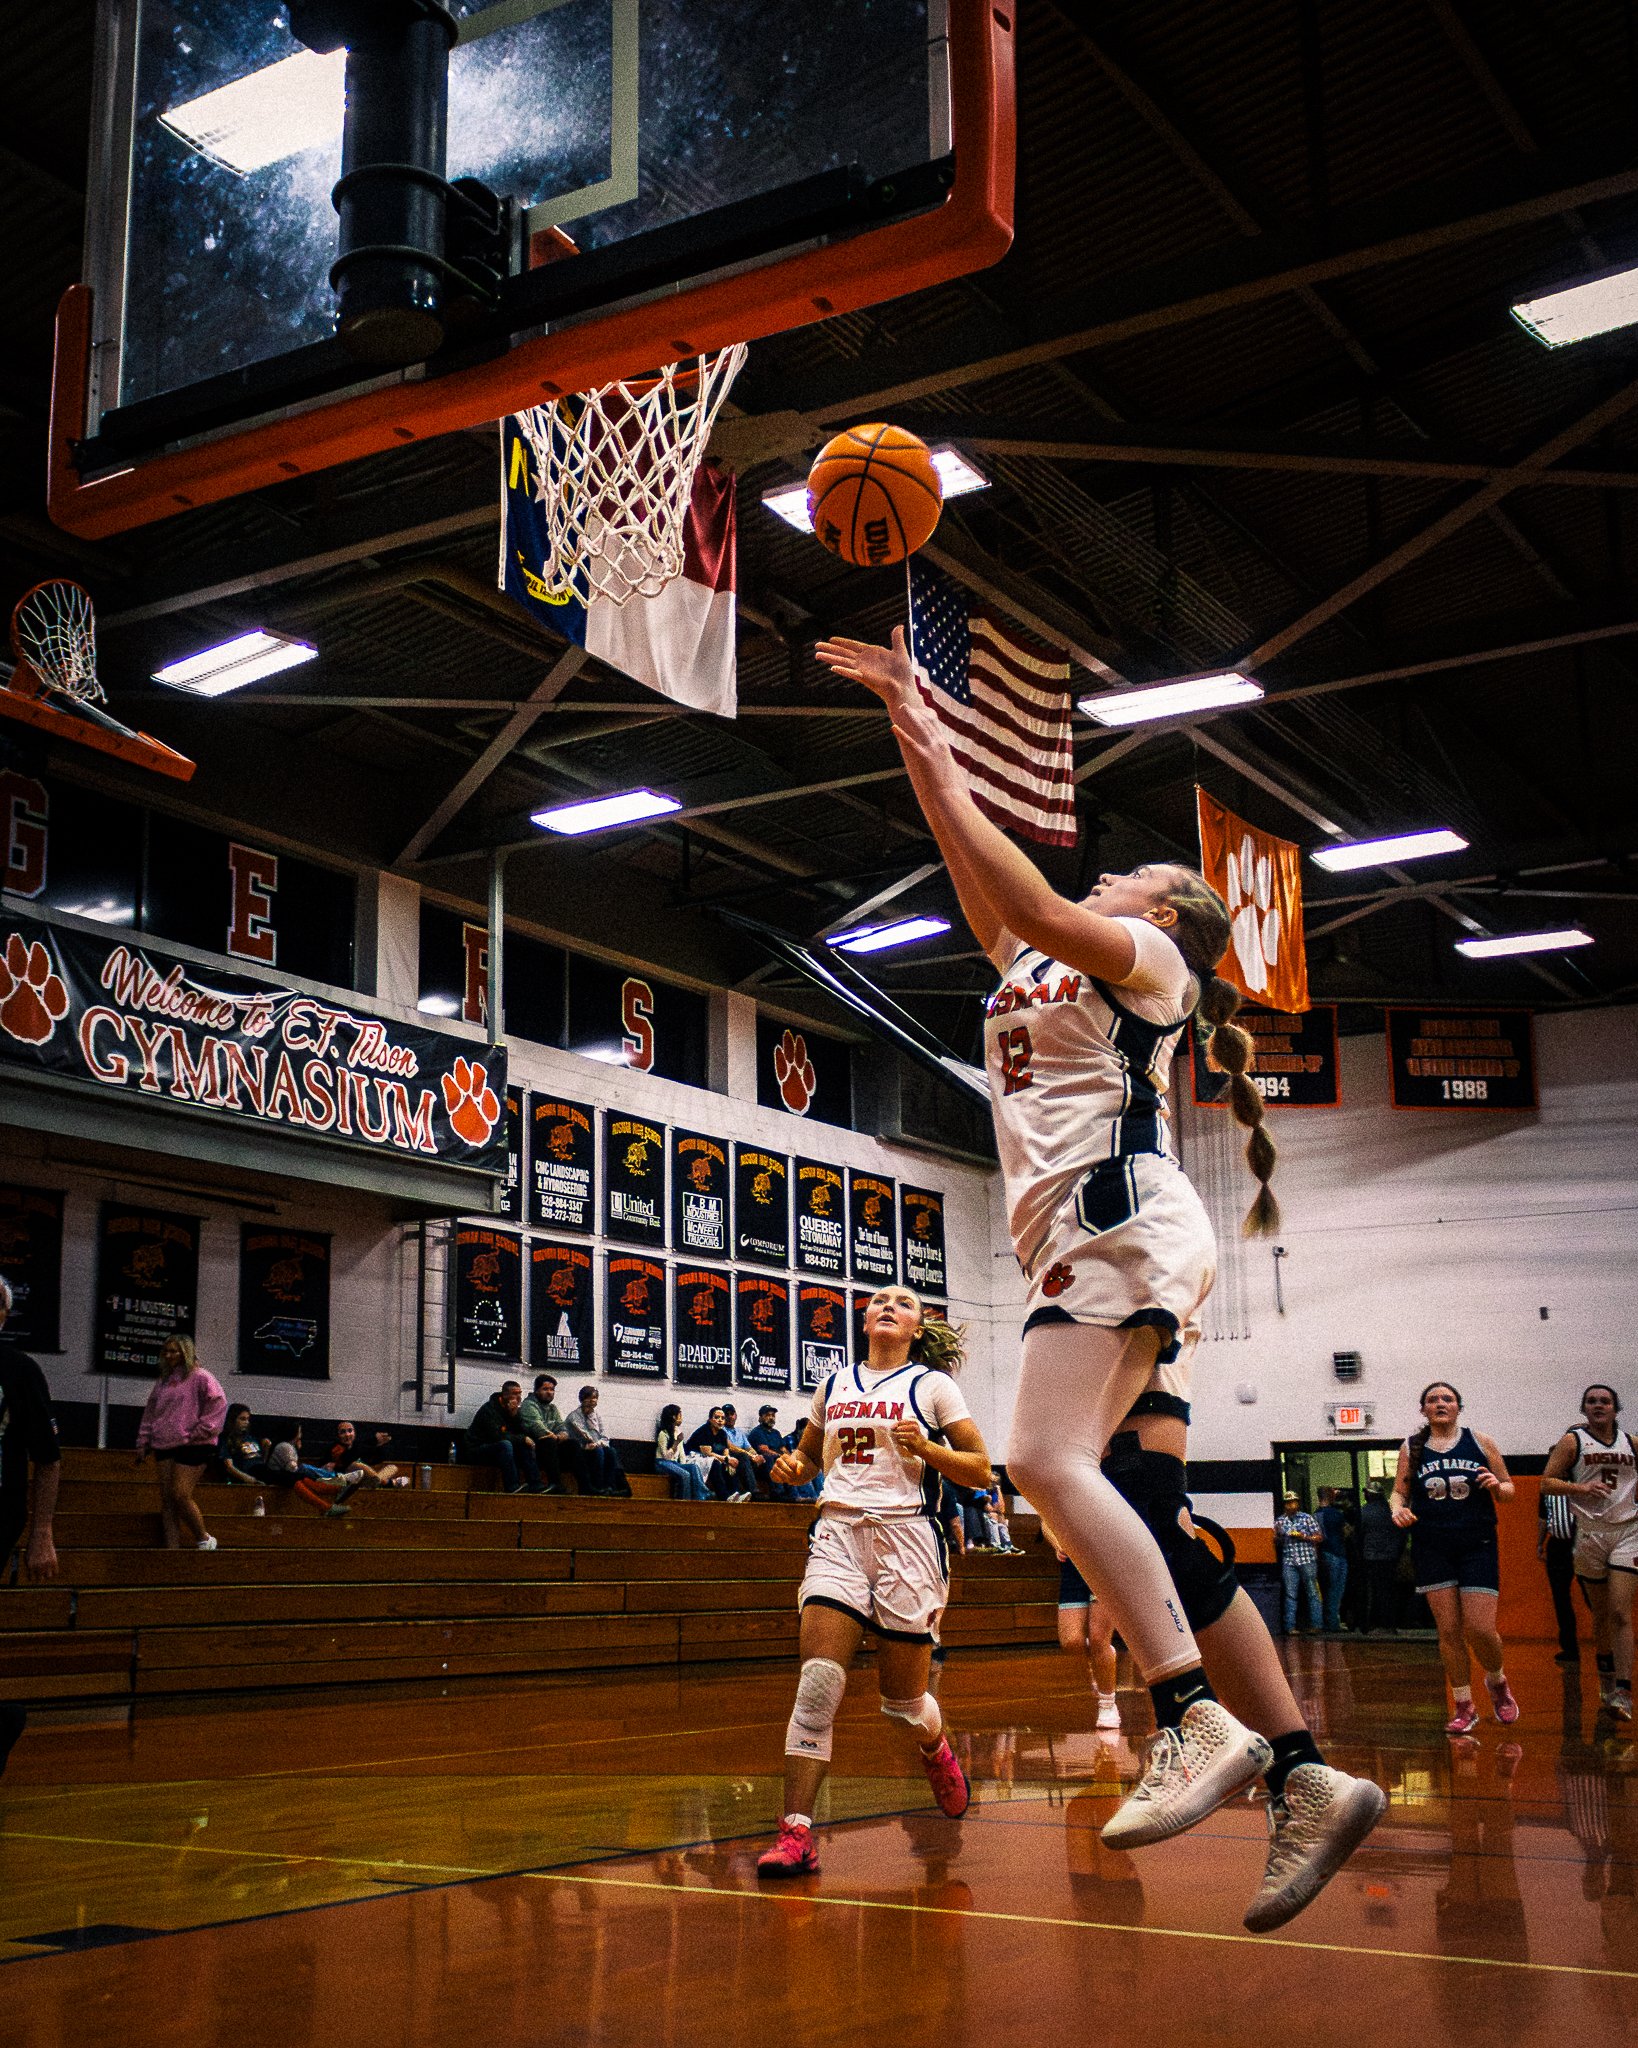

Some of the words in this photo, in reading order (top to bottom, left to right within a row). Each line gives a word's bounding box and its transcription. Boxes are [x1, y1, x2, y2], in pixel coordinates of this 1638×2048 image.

[227, 841, 278, 966] E
[621, 977, 654, 1073] S
[101, 946, 234, 1030] Welcome
[239, 993, 275, 1036] to
[339, 1009, 418, 1076] Tilson
[998, 1025, 1033, 1097] 12
[79, 1006, 439, 1153] GYMNASIUM
[1254, 1077, 1290, 1097] 994
[1442, 1080, 1488, 1099] 1988
[550, 1163, 590, 1182] LANDSCAPING
[623, 1193, 654, 1216] United
[800, 1215, 842, 1236] QUEBEC
[804, 1253, 839, 1270] 884-8712
[547, 1335, 562, 1348] BLUE
[687, 1344, 731, 1365] PARDEE
[827, 1401, 904, 1422] ROSMAN
[1341, 1408, 1359, 1423] EXIT
[838, 1427, 875, 1465] 22
